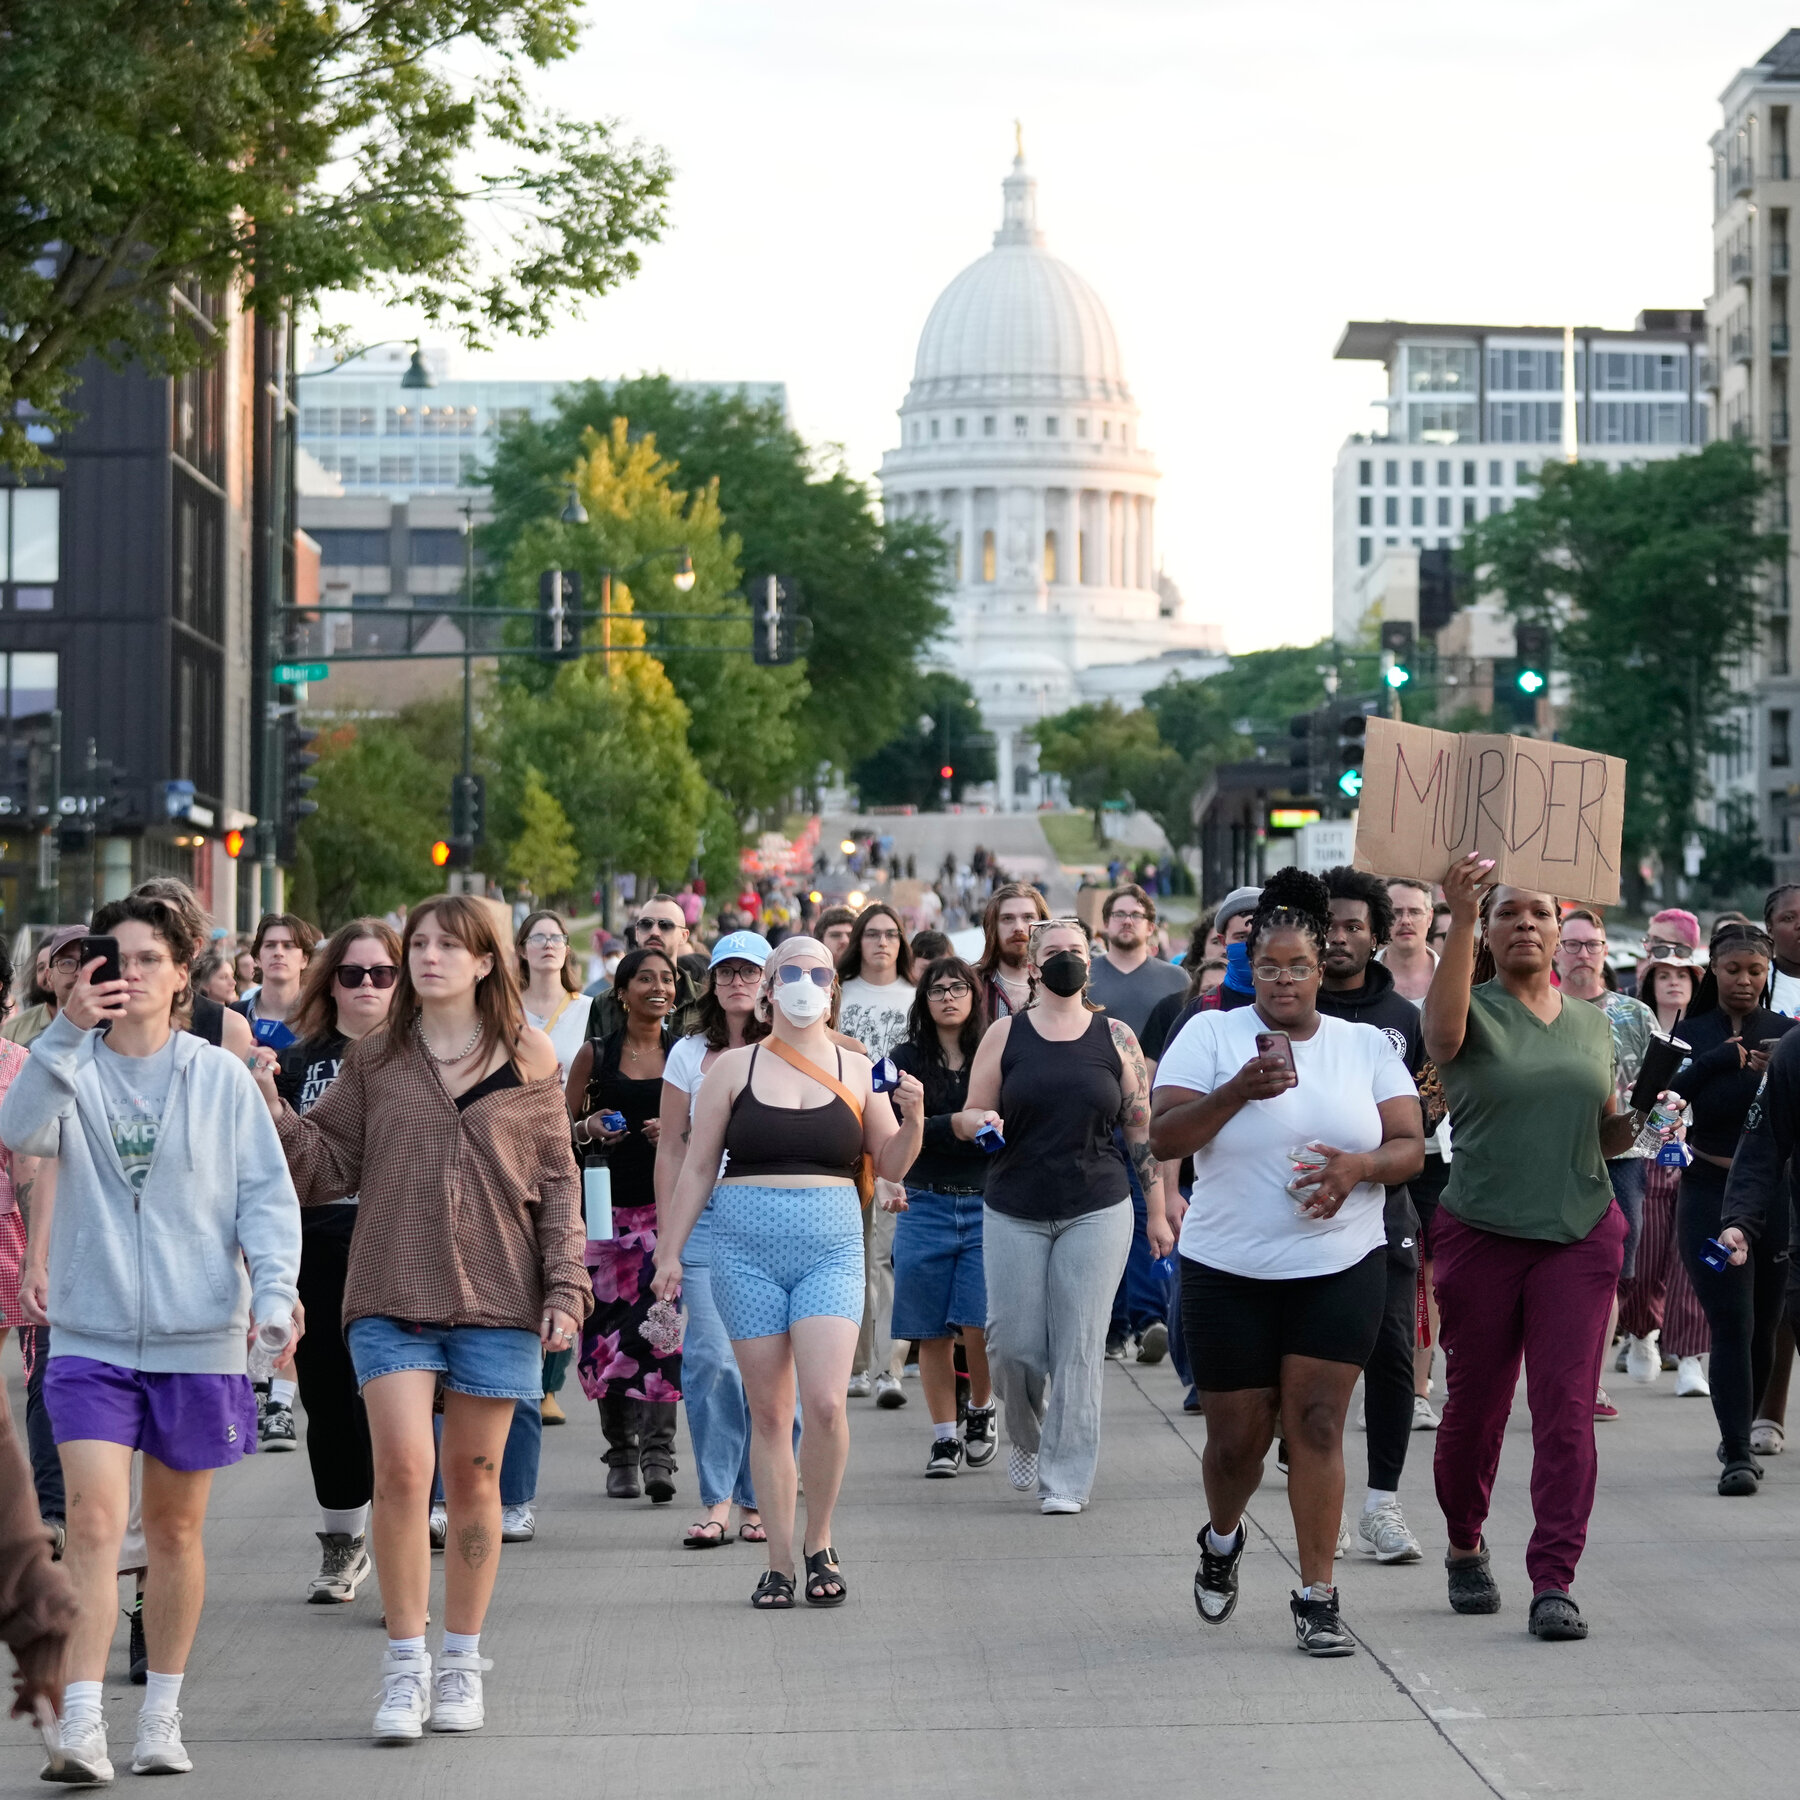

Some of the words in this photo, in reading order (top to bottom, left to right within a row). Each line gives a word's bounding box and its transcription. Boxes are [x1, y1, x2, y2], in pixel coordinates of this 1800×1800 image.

[1391, 743, 1613, 872] MURDER
[1316, 832, 1344, 844] LEFT
[1316, 848, 1346, 860] TURN
[306, 1060, 326, 1081] IF
[1417, 1286, 1425, 1328] HOUSING
